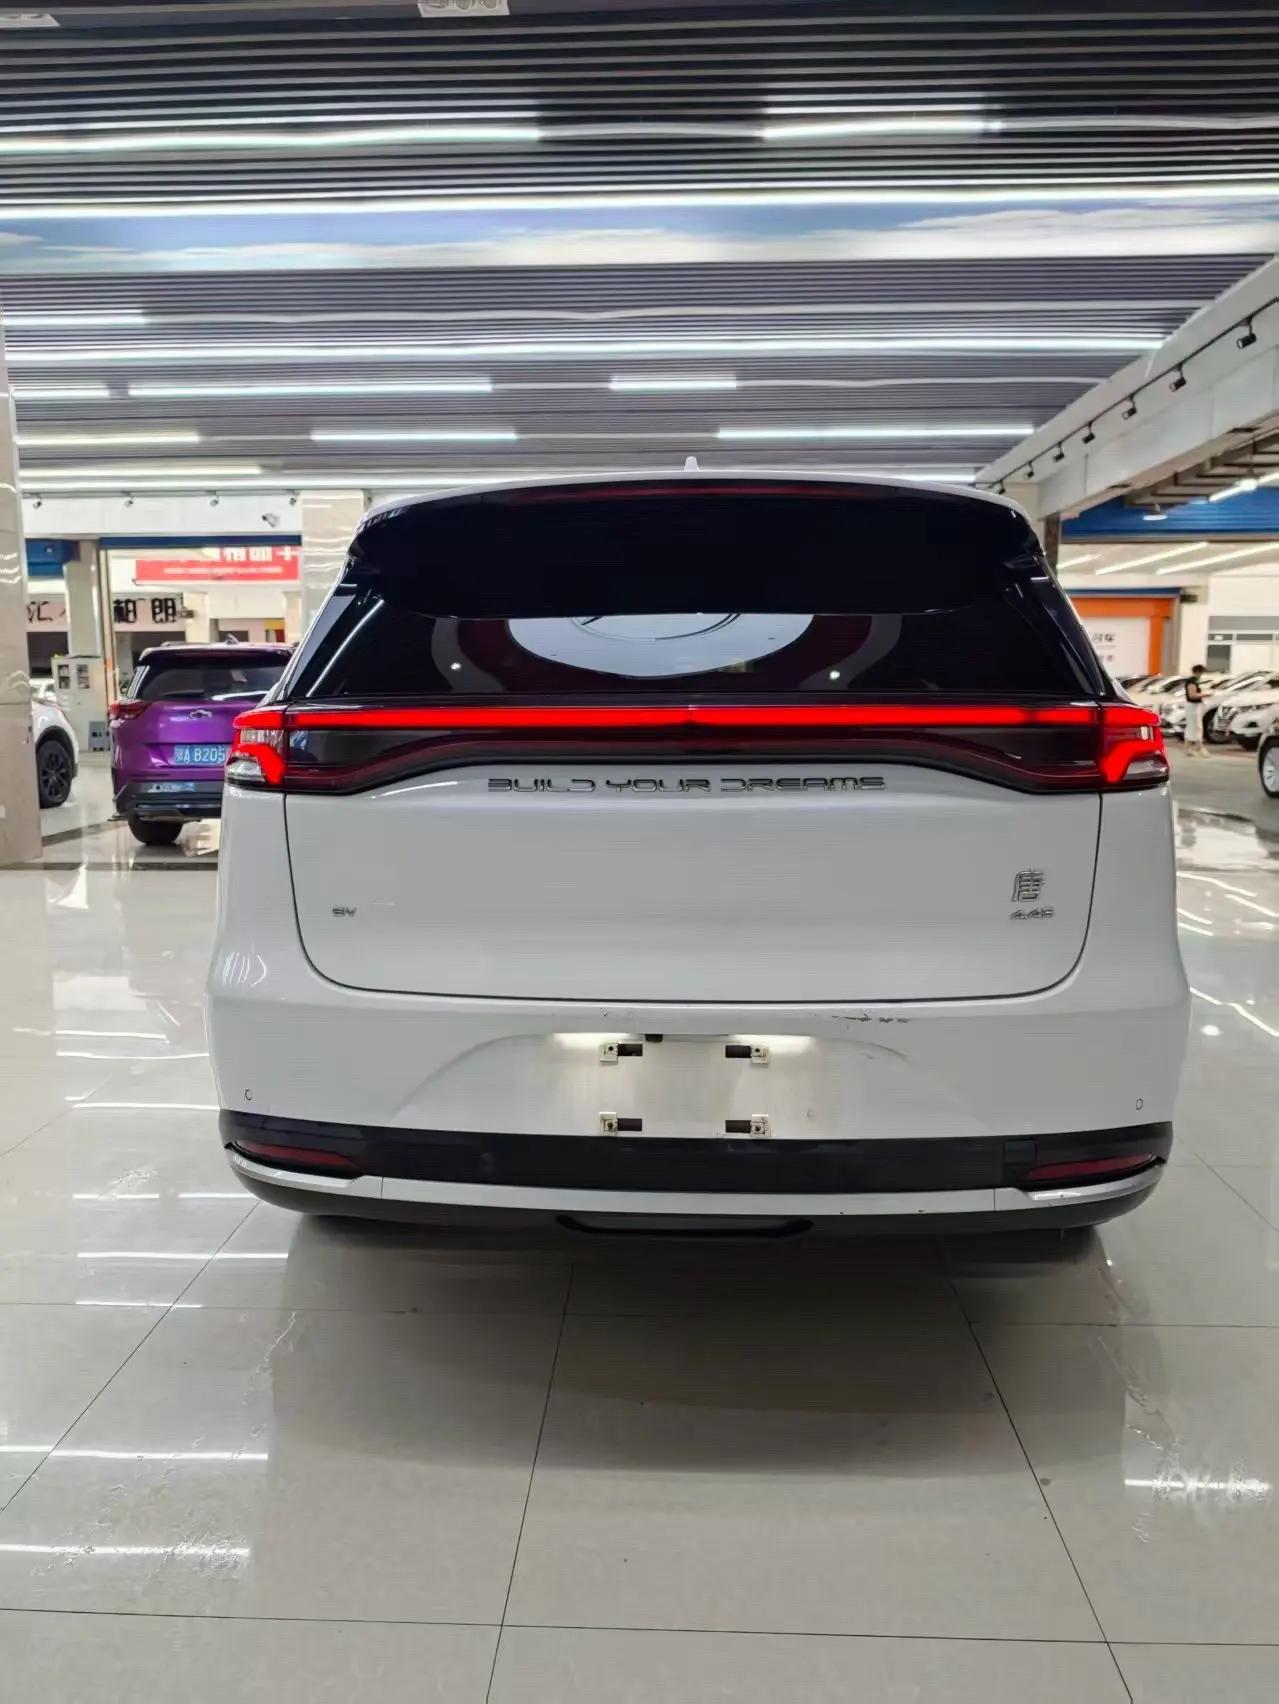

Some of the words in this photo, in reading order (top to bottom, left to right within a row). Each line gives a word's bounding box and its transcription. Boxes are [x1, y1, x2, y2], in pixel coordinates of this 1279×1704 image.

[487, 778, 596, 793] BUILD
[605, 778, 711, 793] YOUR
[720, 776, 887, 793] DREAMS
[331, 906, 358, 918] EV
